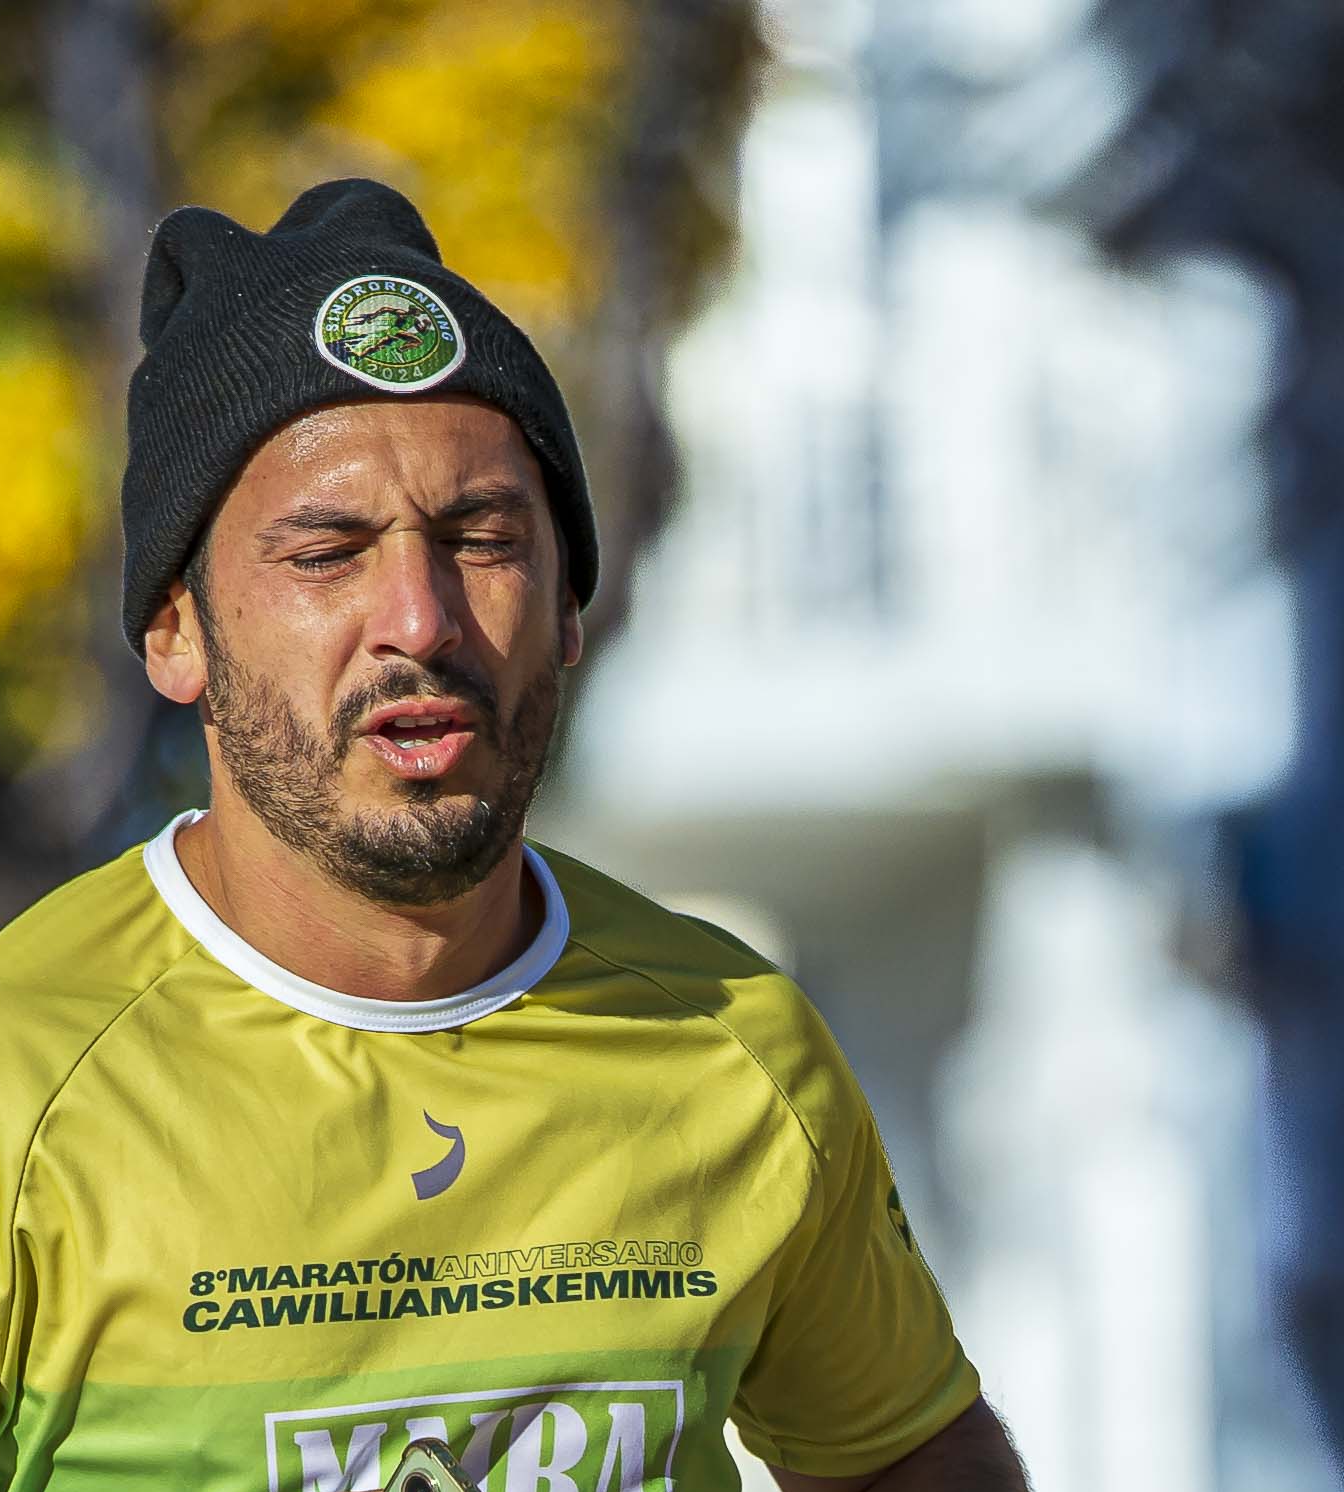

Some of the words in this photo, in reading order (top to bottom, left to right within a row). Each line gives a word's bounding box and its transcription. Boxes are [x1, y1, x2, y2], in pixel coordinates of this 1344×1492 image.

[325, 280, 454, 343] SINDRORUNNING
[366, 362, 424, 383] 2024
[181, 1269, 719, 1334] CAWILLIAMSKEMMIS
